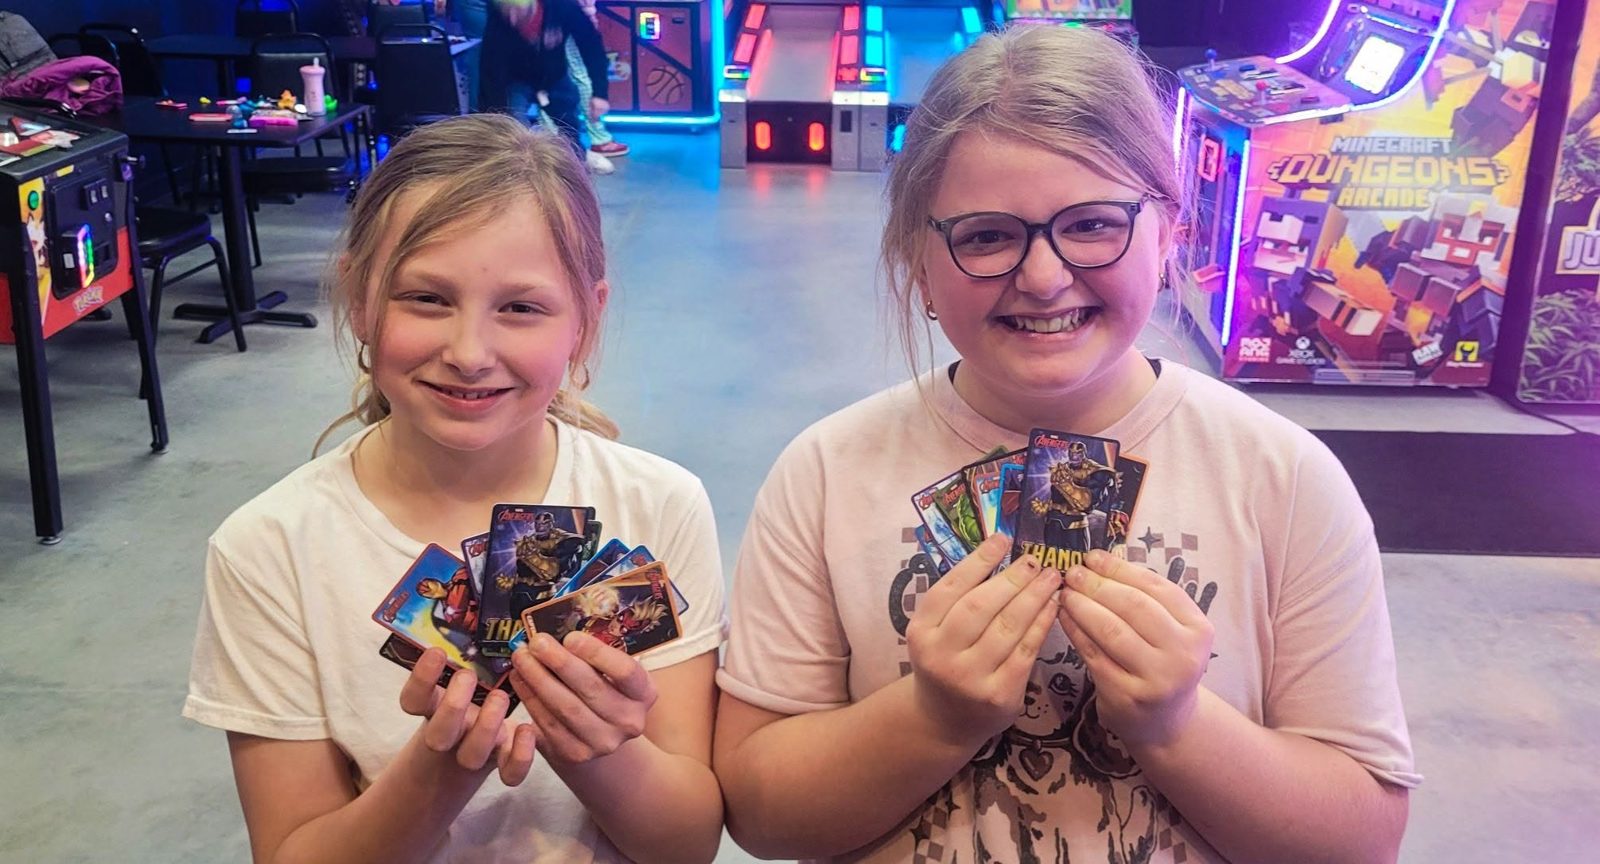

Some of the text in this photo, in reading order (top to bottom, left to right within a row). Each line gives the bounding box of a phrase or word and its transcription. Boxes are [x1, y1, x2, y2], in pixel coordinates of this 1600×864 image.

[1330, 137, 1452, 154] MINECRAFT
[1278, 154, 1496, 186] DUNGEONS
[1336, 187, 1431, 208] ARCADE
[1021, 541, 1089, 571] THANO
